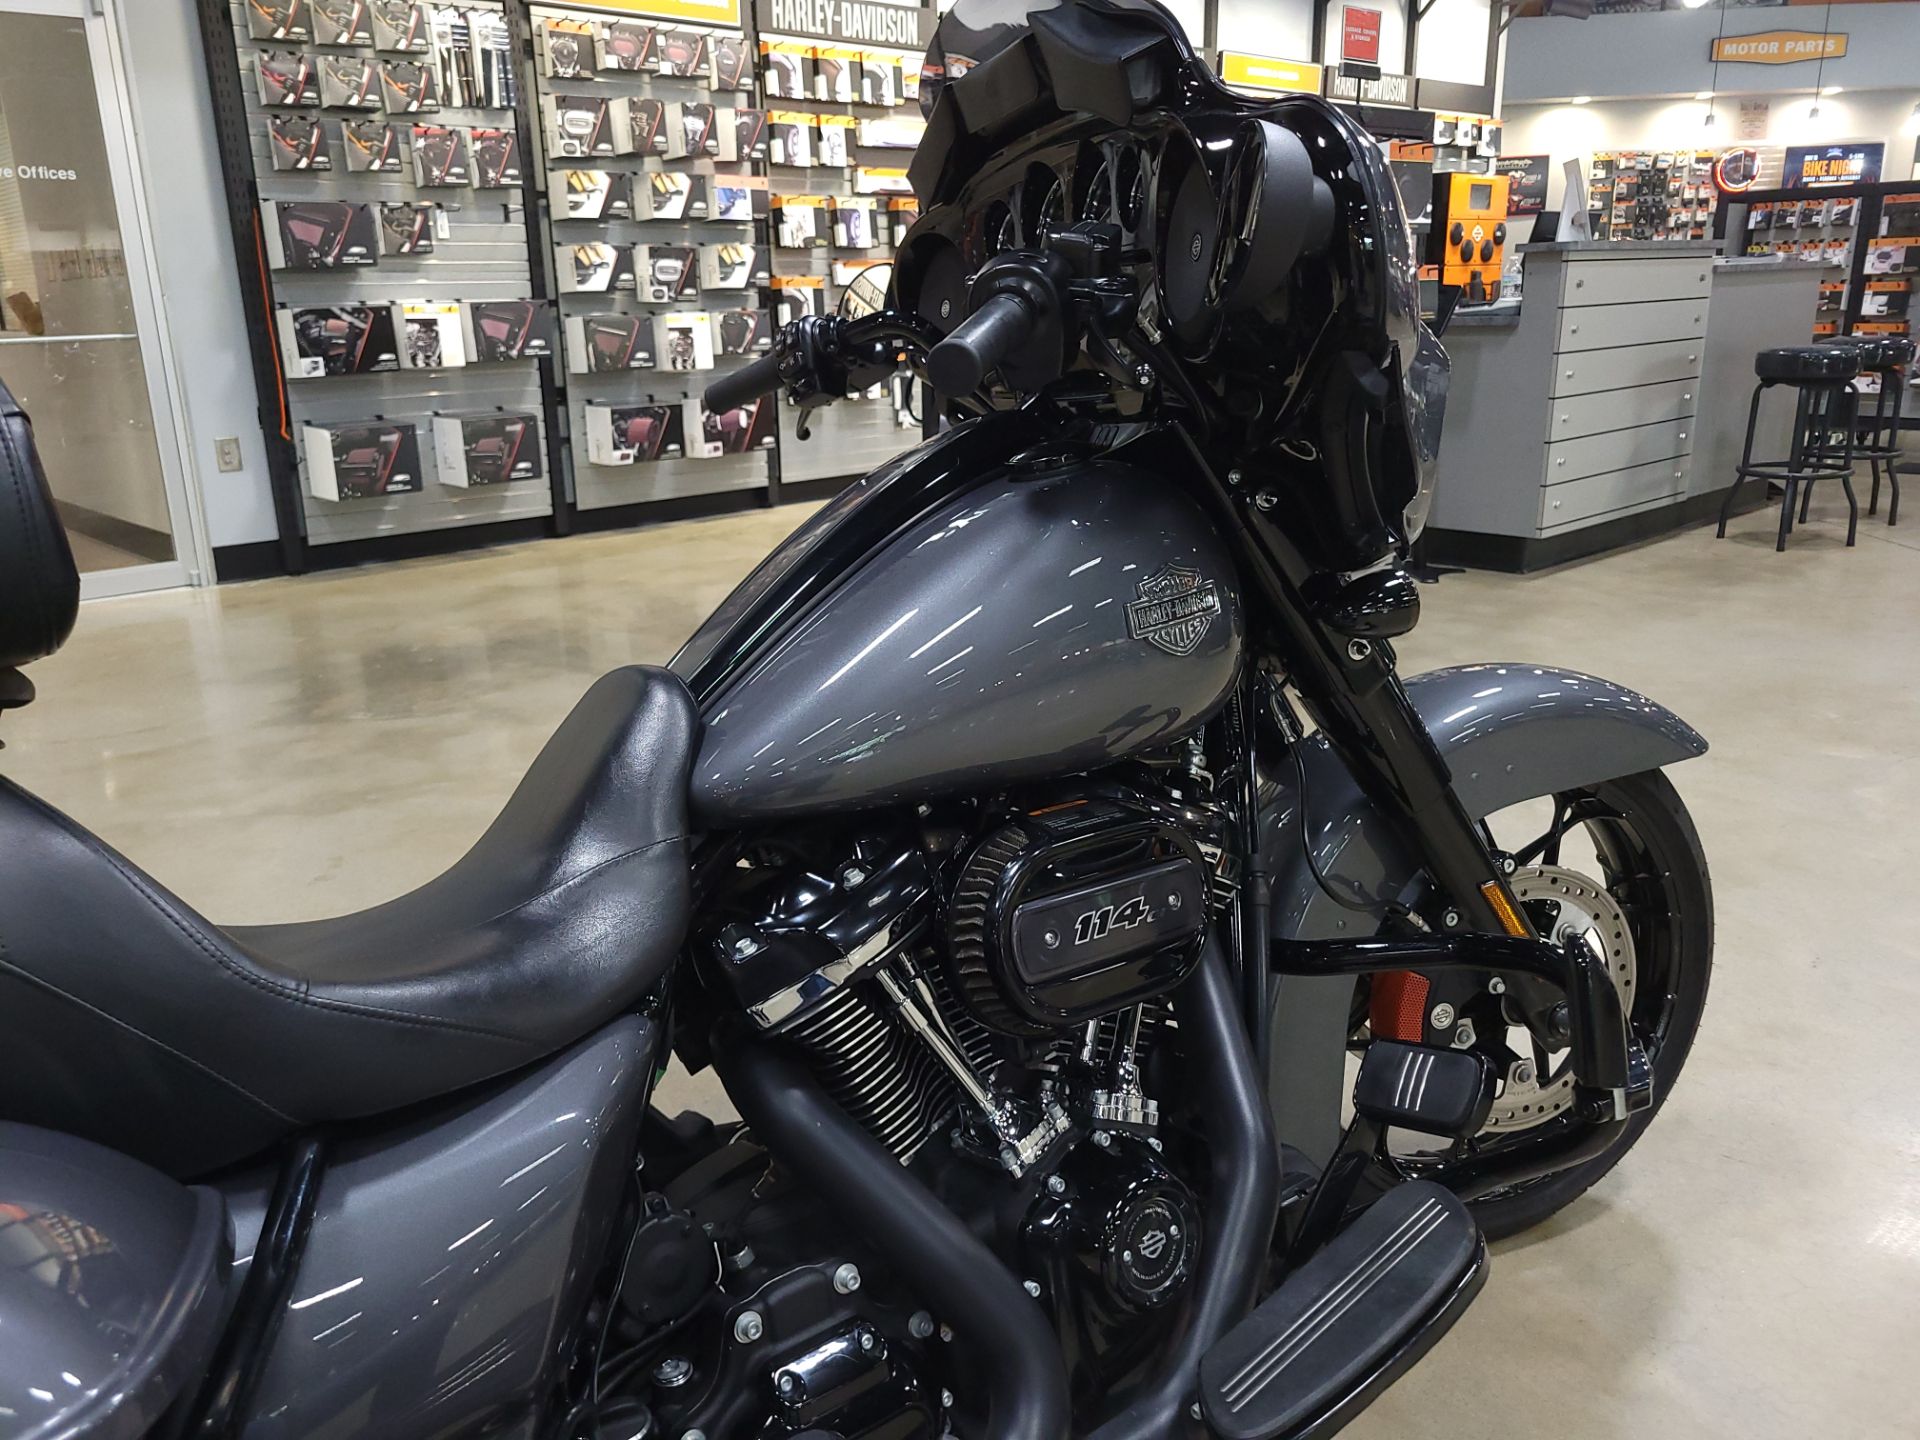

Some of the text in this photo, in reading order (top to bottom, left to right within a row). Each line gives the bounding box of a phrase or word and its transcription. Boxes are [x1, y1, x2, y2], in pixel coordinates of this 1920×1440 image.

[771, 0, 918, 45] HARLEY-DAVIDSON
[1724, 39, 1836, 55] MOTOR PARTS
[1334, 68, 1408, 103] HARLY-DAVIDSON
[17, 165, 77, 180] Offices
[1802, 159, 1864, 176] BIKE NIG
[1161, 618, 1201, 647] CYCLES
[1074, 896, 1150, 945] 114
